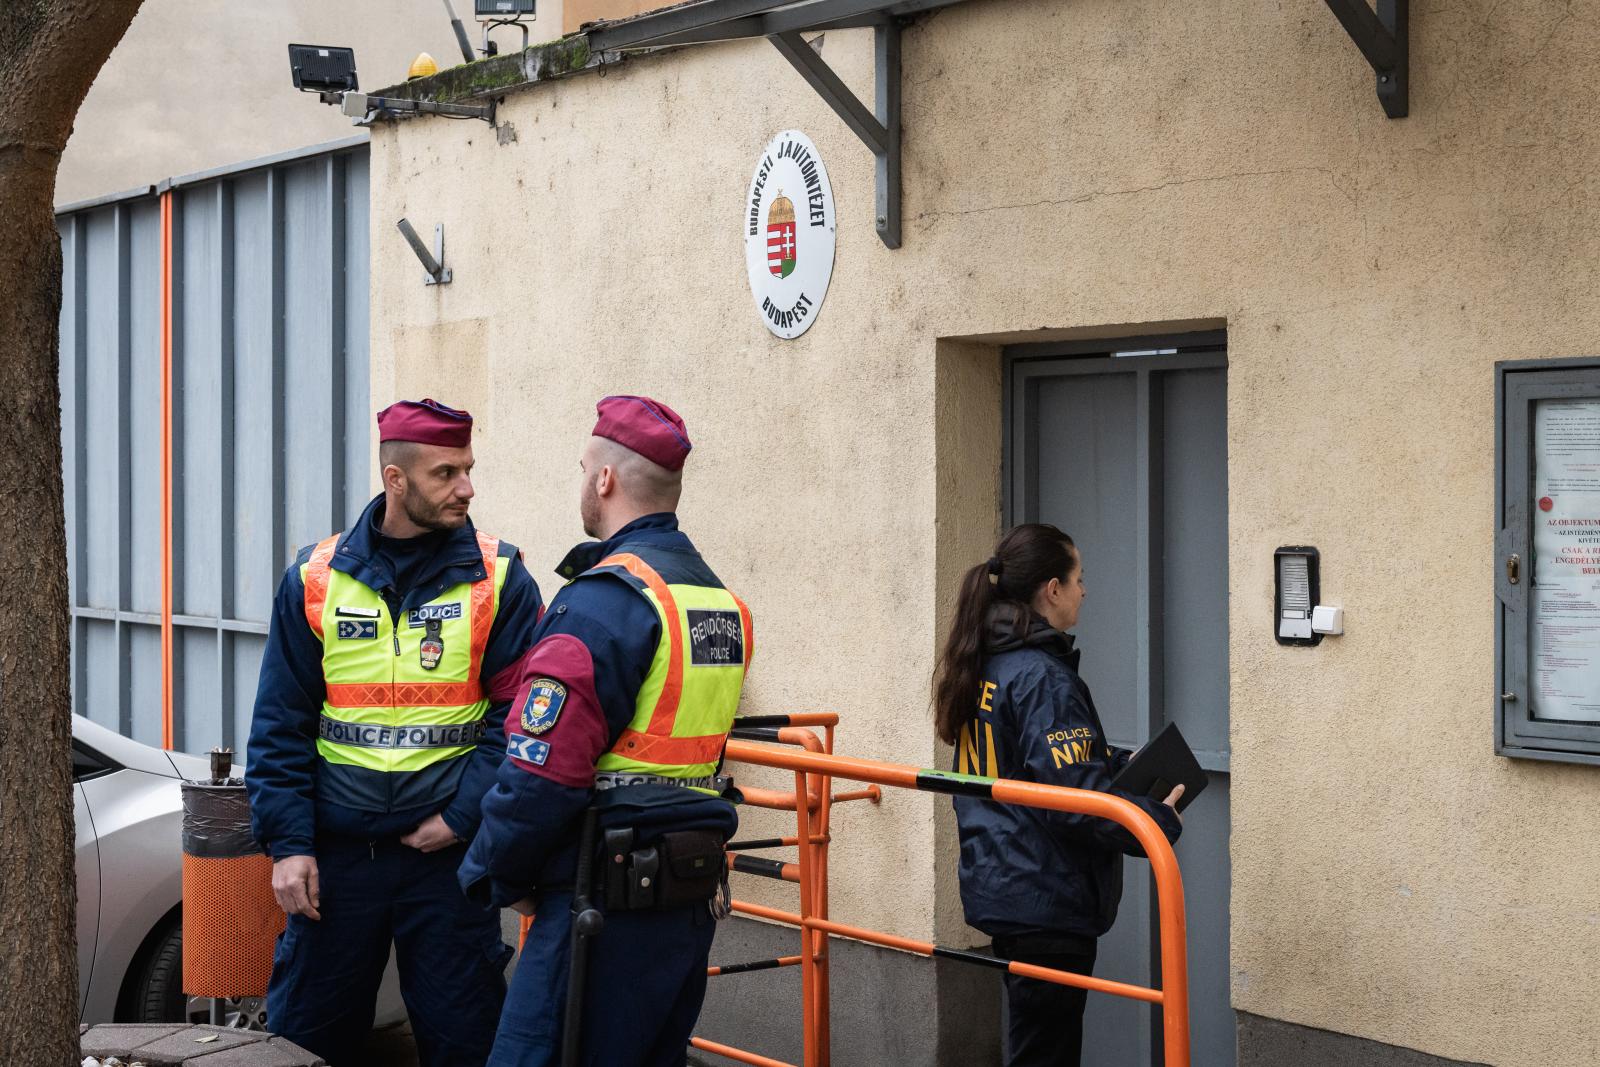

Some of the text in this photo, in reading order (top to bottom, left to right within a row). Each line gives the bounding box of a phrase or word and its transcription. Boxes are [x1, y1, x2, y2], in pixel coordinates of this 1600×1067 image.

[749, 140, 825, 236] BUDAPESTI JAVÍTÓINTÉZET
[761, 291, 814, 329] BUDAPEST
[410, 605, 460, 621] POLICE
[710, 647, 730, 660] POLICE
[326, 723, 390, 745] POLICE
[396, 727, 468, 746] POLICE
[1046, 727, 1092, 745] POLICE
[1051, 739, 1092, 769] NNI
